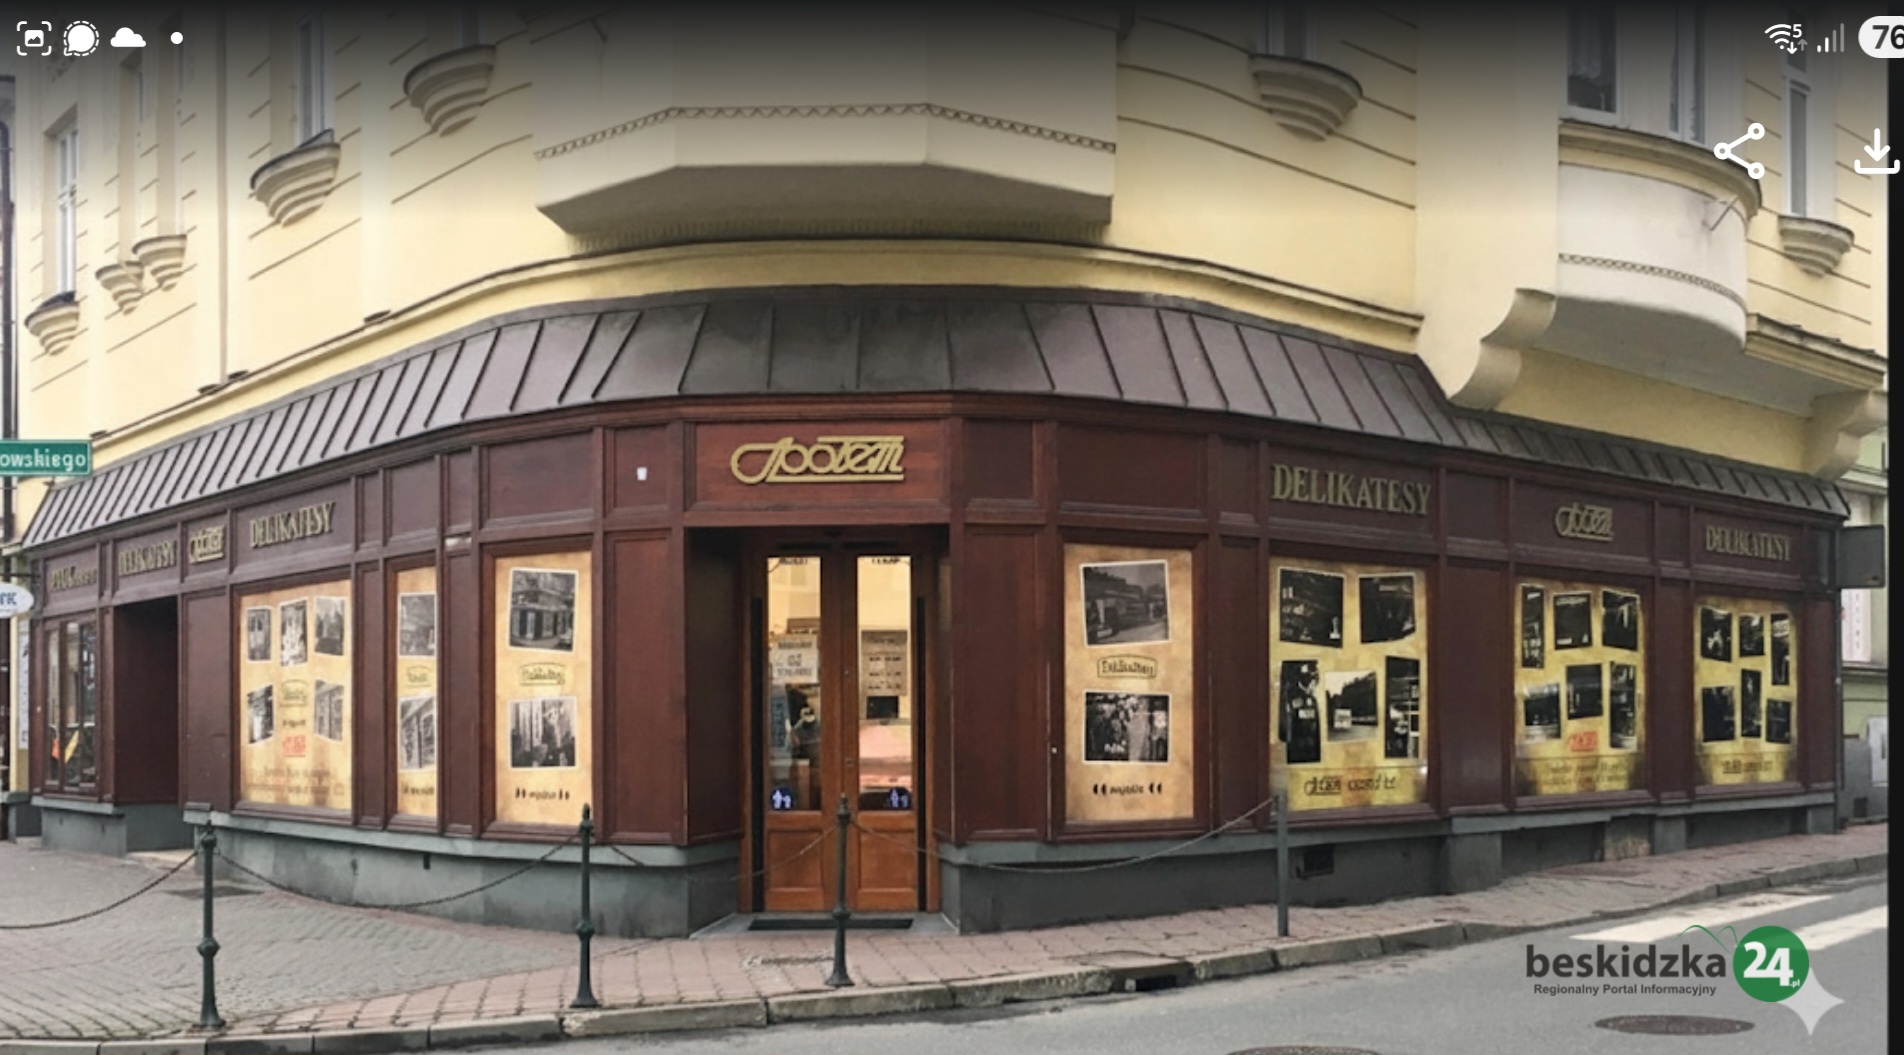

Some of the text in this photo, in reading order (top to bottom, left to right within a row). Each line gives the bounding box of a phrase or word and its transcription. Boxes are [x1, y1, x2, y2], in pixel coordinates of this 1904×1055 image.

[0, 448, 86, 472] owskiego
[1271, 462, 1431, 516] DELIKATESY
[249, 501, 337, 548] DELIKATESY
